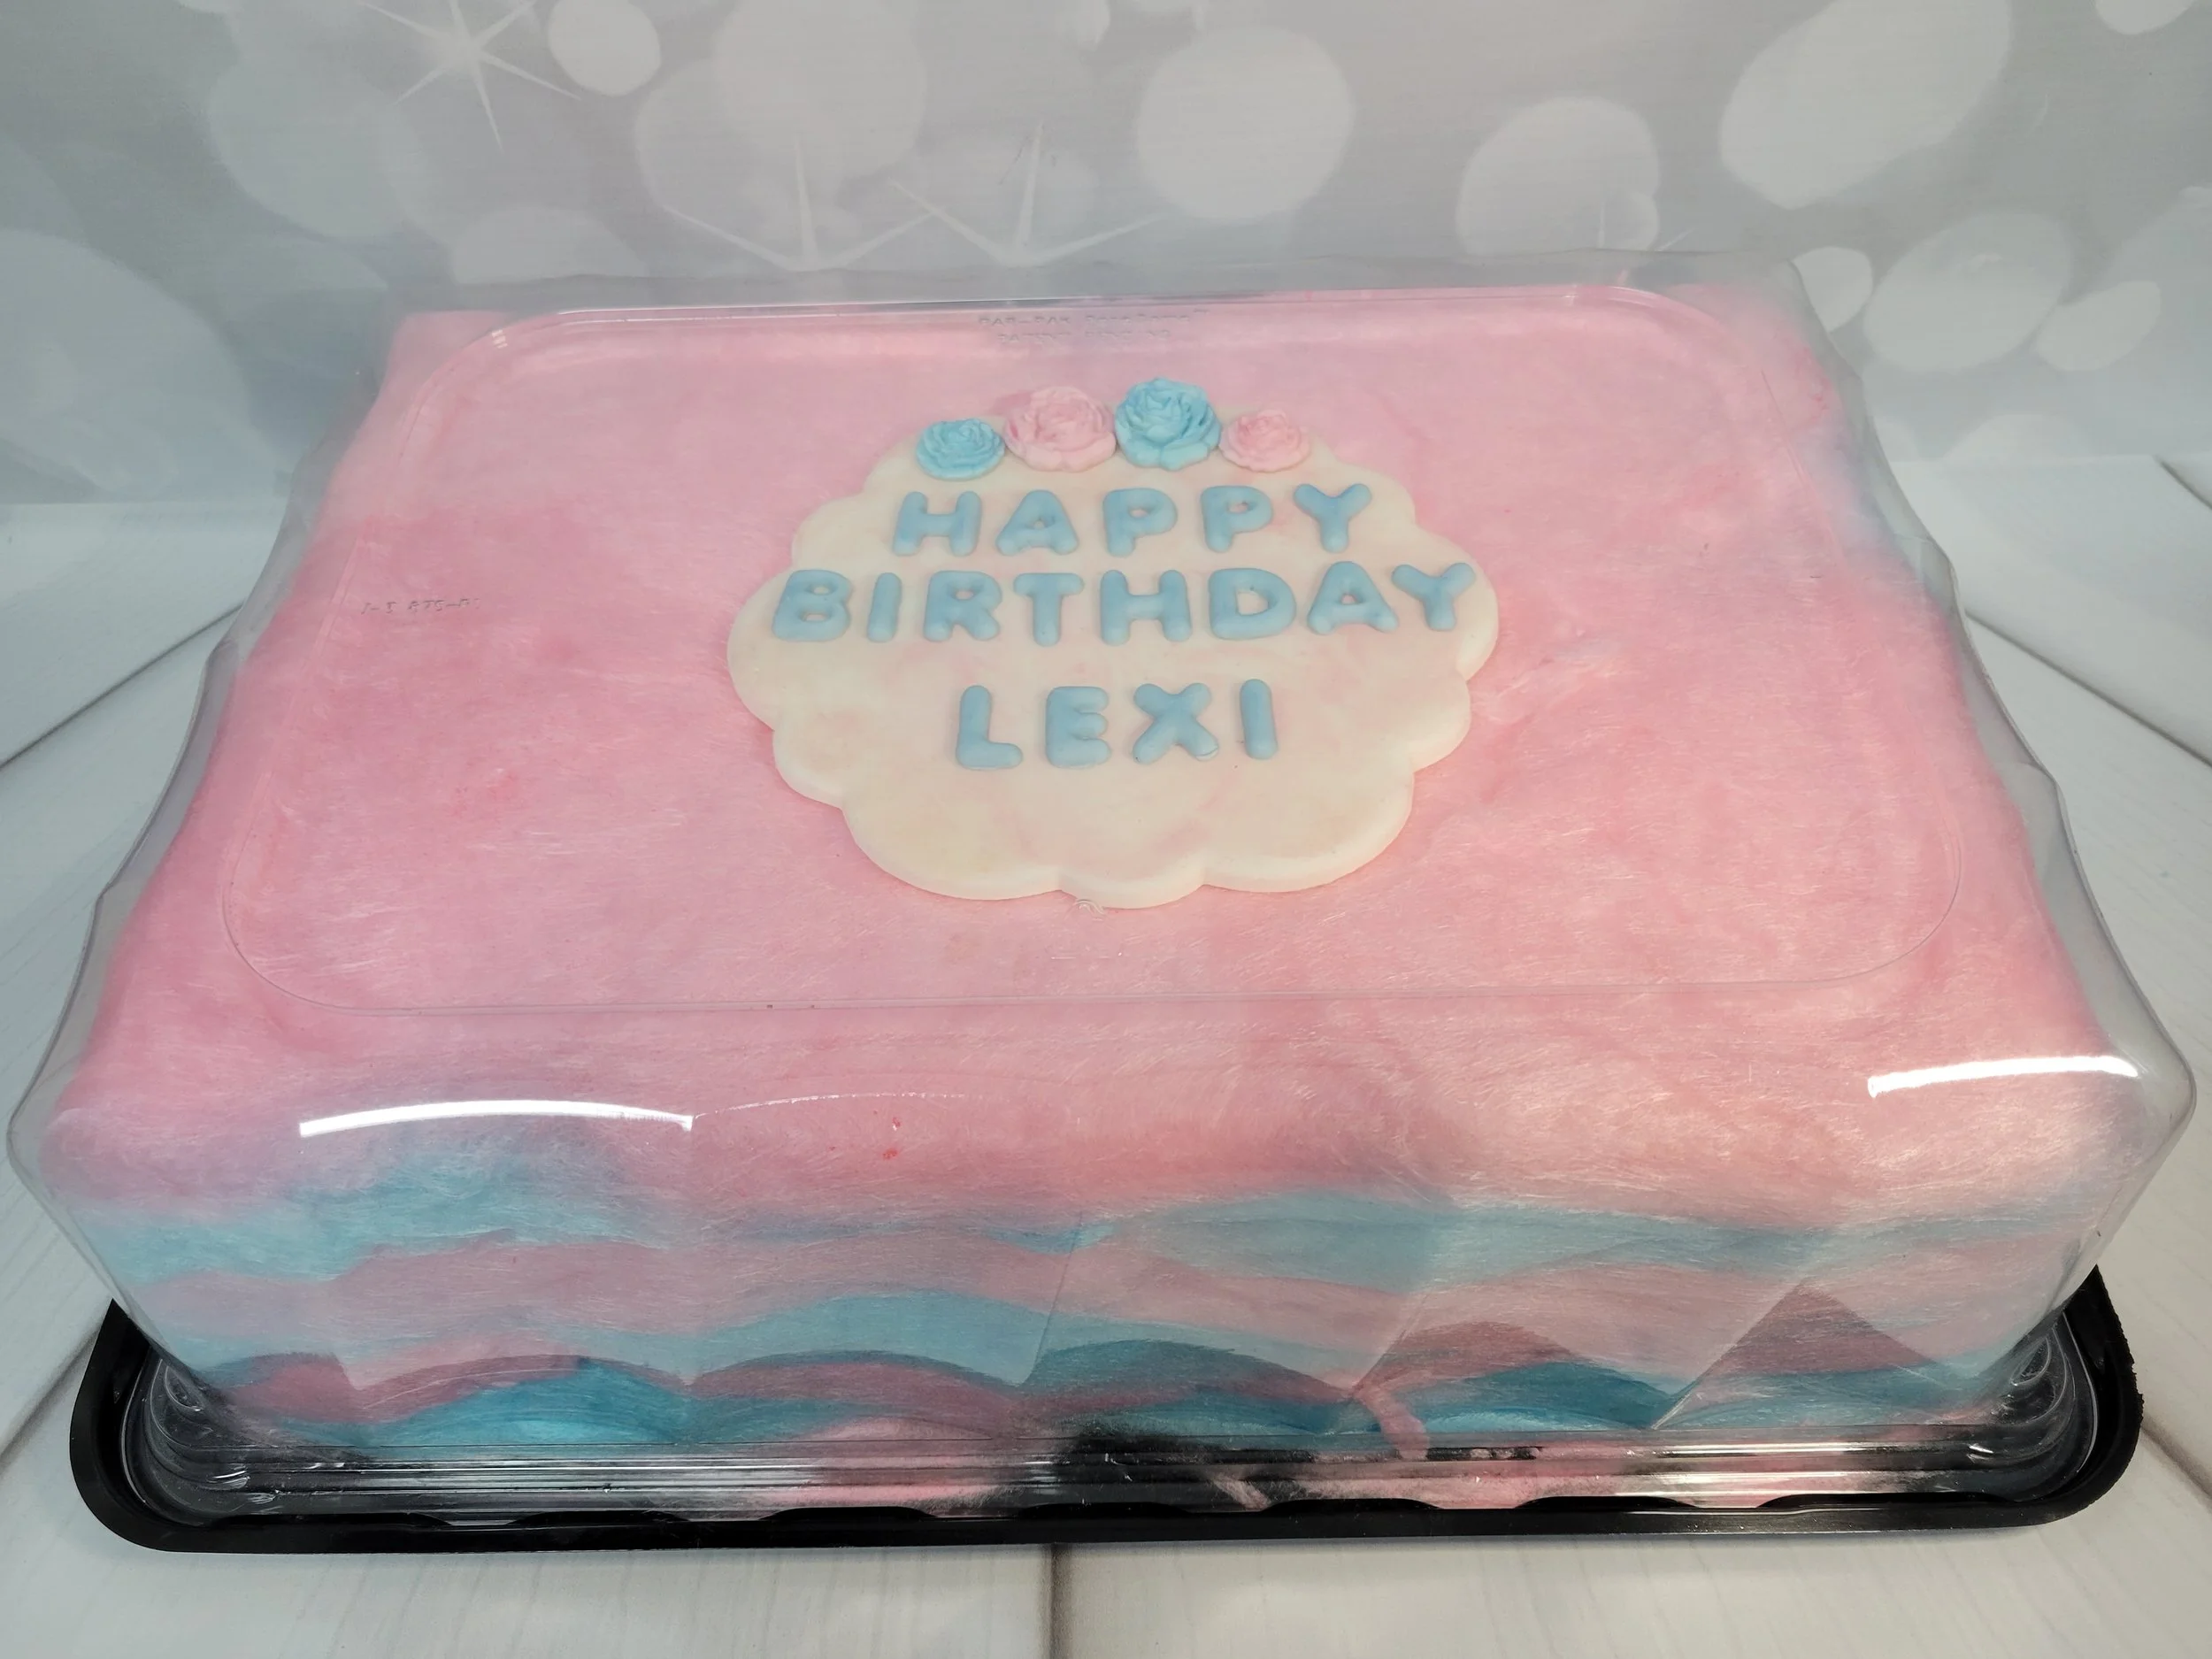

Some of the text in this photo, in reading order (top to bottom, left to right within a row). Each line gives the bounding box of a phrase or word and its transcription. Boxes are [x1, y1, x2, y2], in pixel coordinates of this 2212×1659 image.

[892, 482, 1371, 556] HAPPY
[772, 561, 1476, 646] BIRTHDAY
[956, 678, 1279, 770] LEXI
